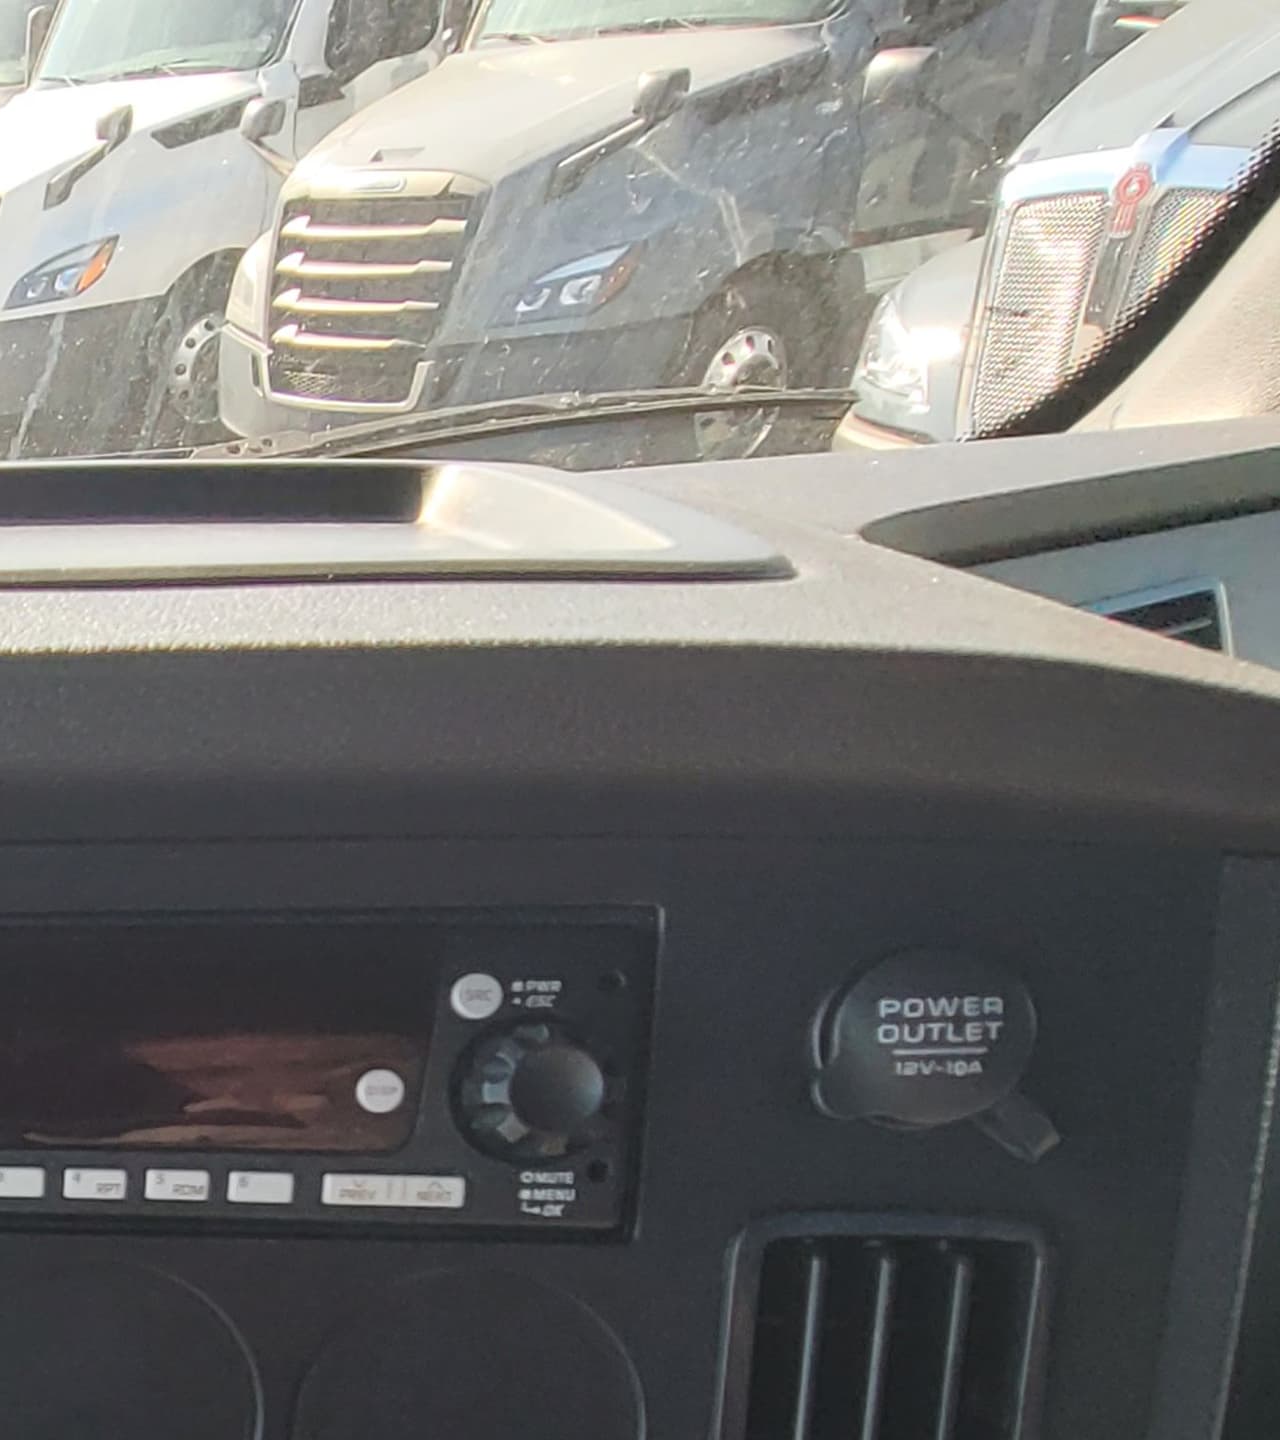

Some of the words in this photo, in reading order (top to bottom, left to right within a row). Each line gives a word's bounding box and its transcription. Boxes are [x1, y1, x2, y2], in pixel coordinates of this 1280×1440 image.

[879, 996, 1004, 1019] POWER
[877, 1020, 1004, 1044] OUTLET
[532, 1188, 577, 1202] MENU
